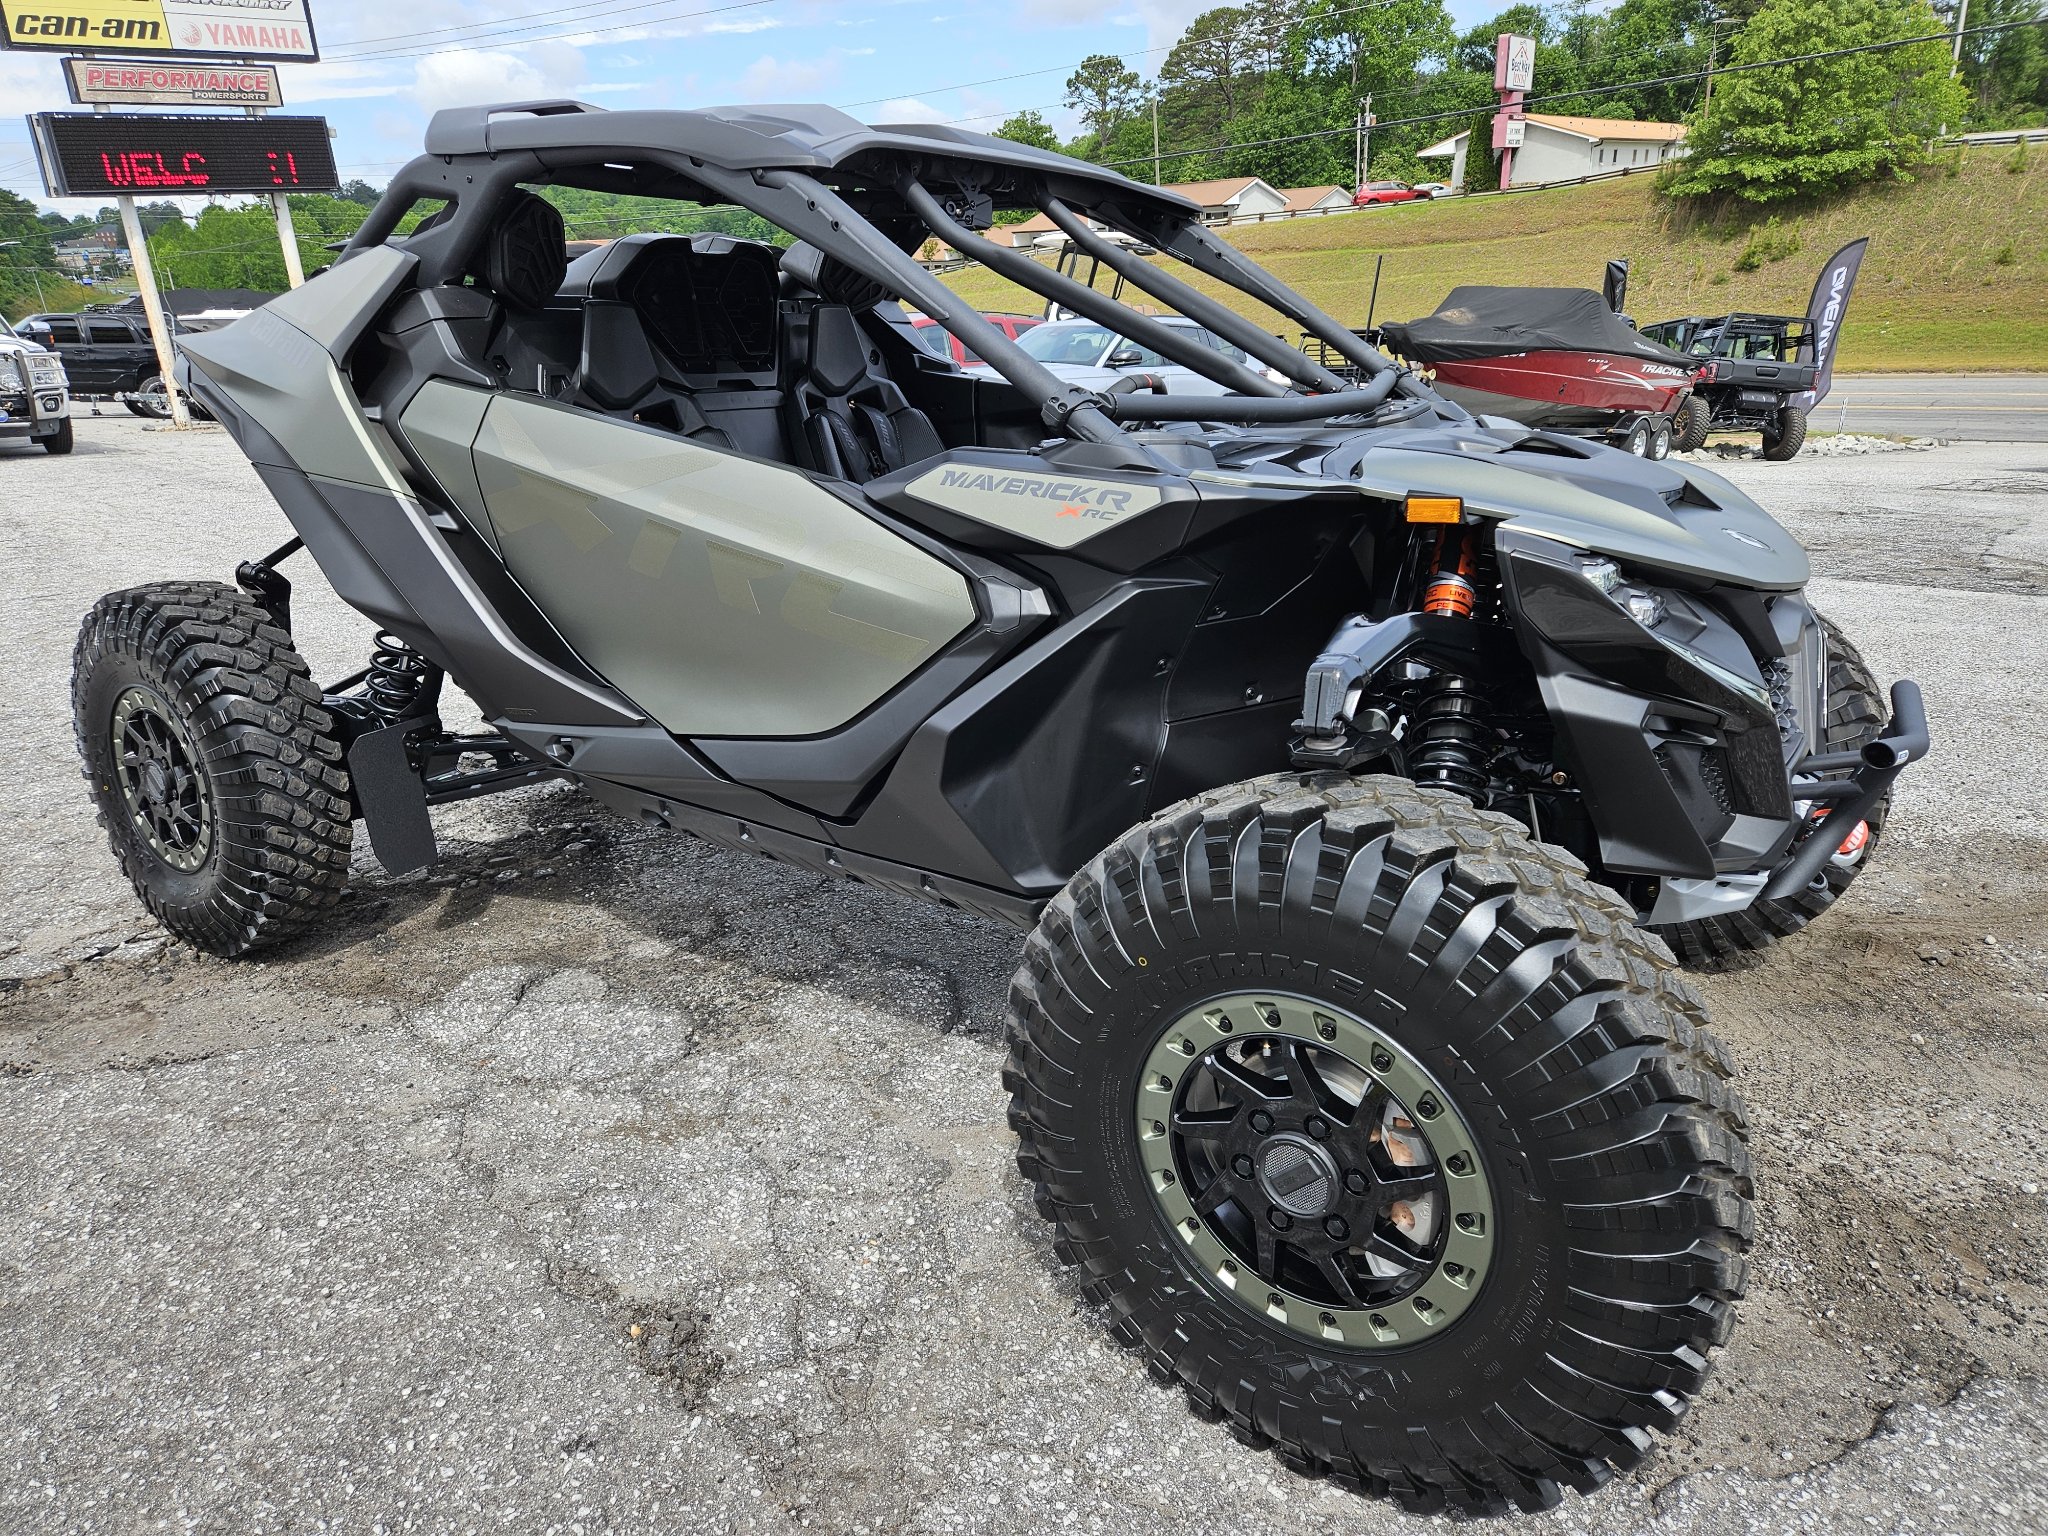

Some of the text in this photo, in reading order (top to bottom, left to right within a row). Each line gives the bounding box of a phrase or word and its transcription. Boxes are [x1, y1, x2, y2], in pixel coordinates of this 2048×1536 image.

[15, 15, 160, 40] can-am
[204, 23, 306, 49] YAMAHA
[86, 67, 270, 92] PERFORMANCE
[194, 91, 266, 100] POWERSPORTS
[939, 470, 1132, 512] MAVERICK R
